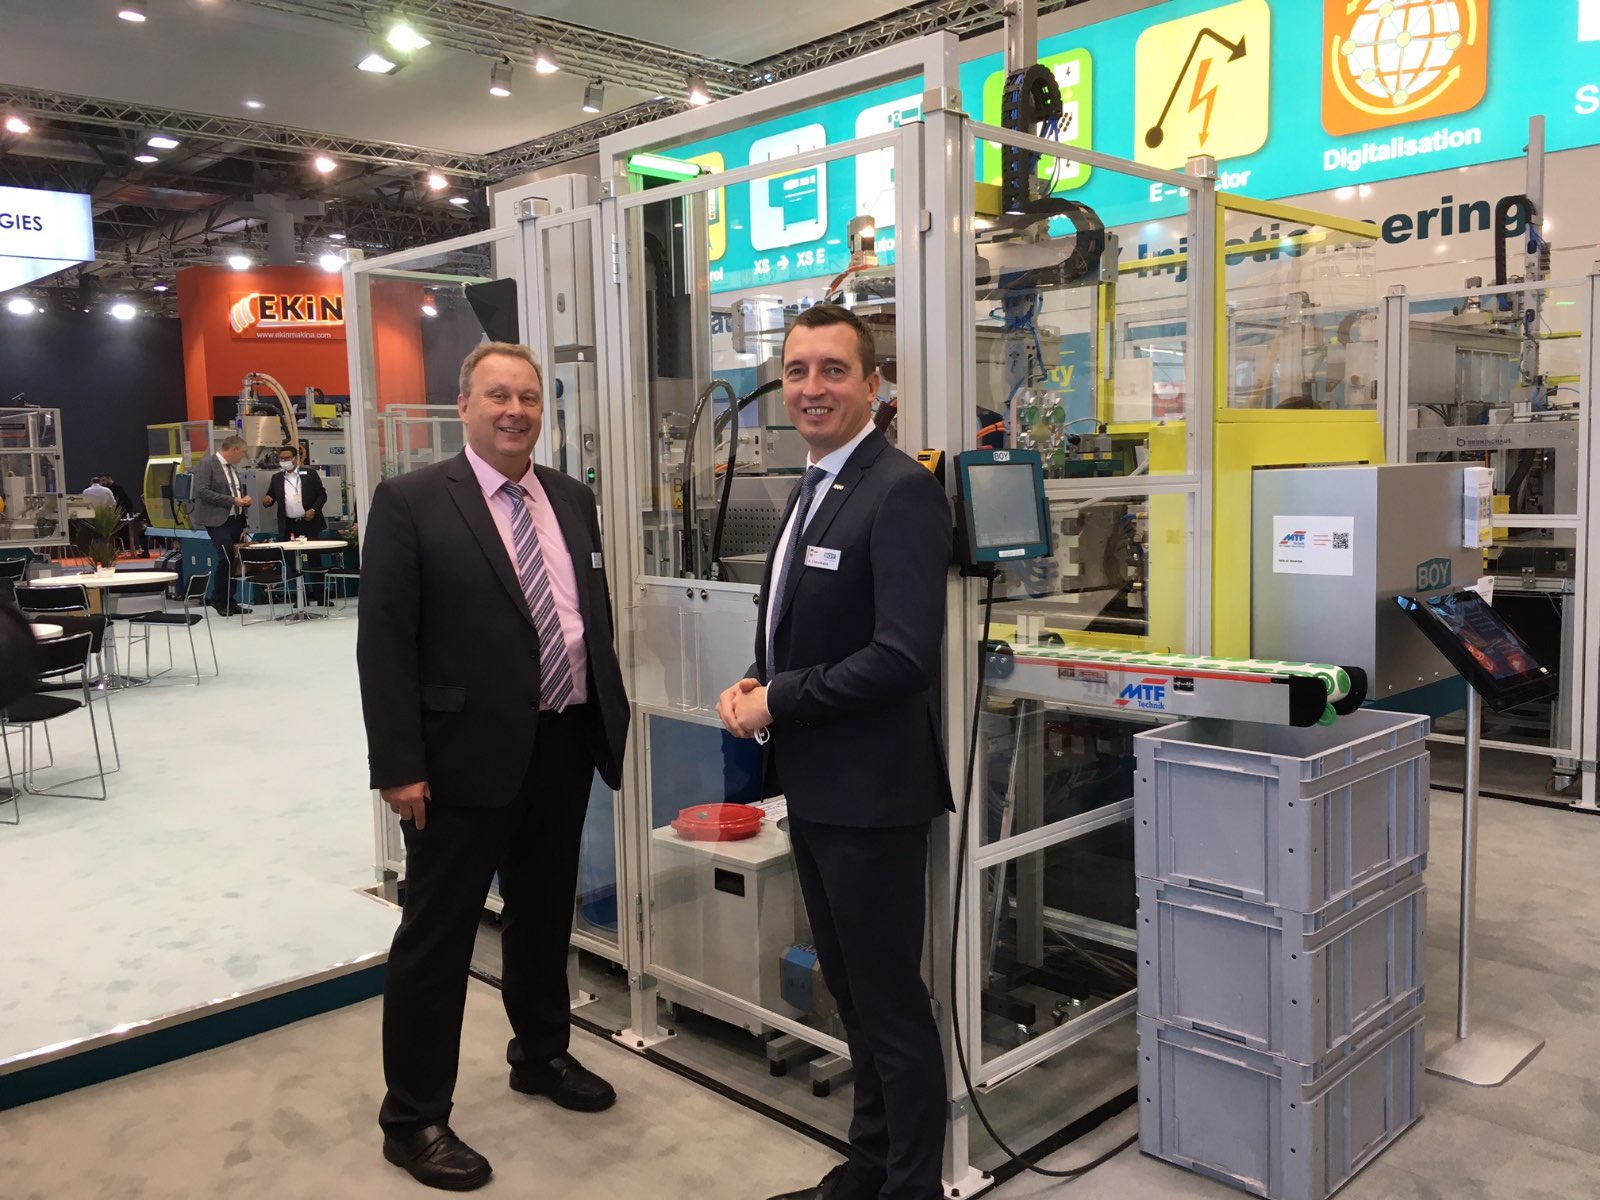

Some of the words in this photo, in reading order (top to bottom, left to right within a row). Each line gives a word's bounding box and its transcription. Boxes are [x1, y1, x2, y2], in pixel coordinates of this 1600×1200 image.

[1323, 128, 1482, 172] Digitalisation
[256, 331, 332, 339] www.ekinmakina.com
[994, 451, 1009, 460] BOY
[1418, 561, 1450, 590] BOY
[1120, 684, 1166, 701] MTF
[1137, 700, 1166, 710] Technik
